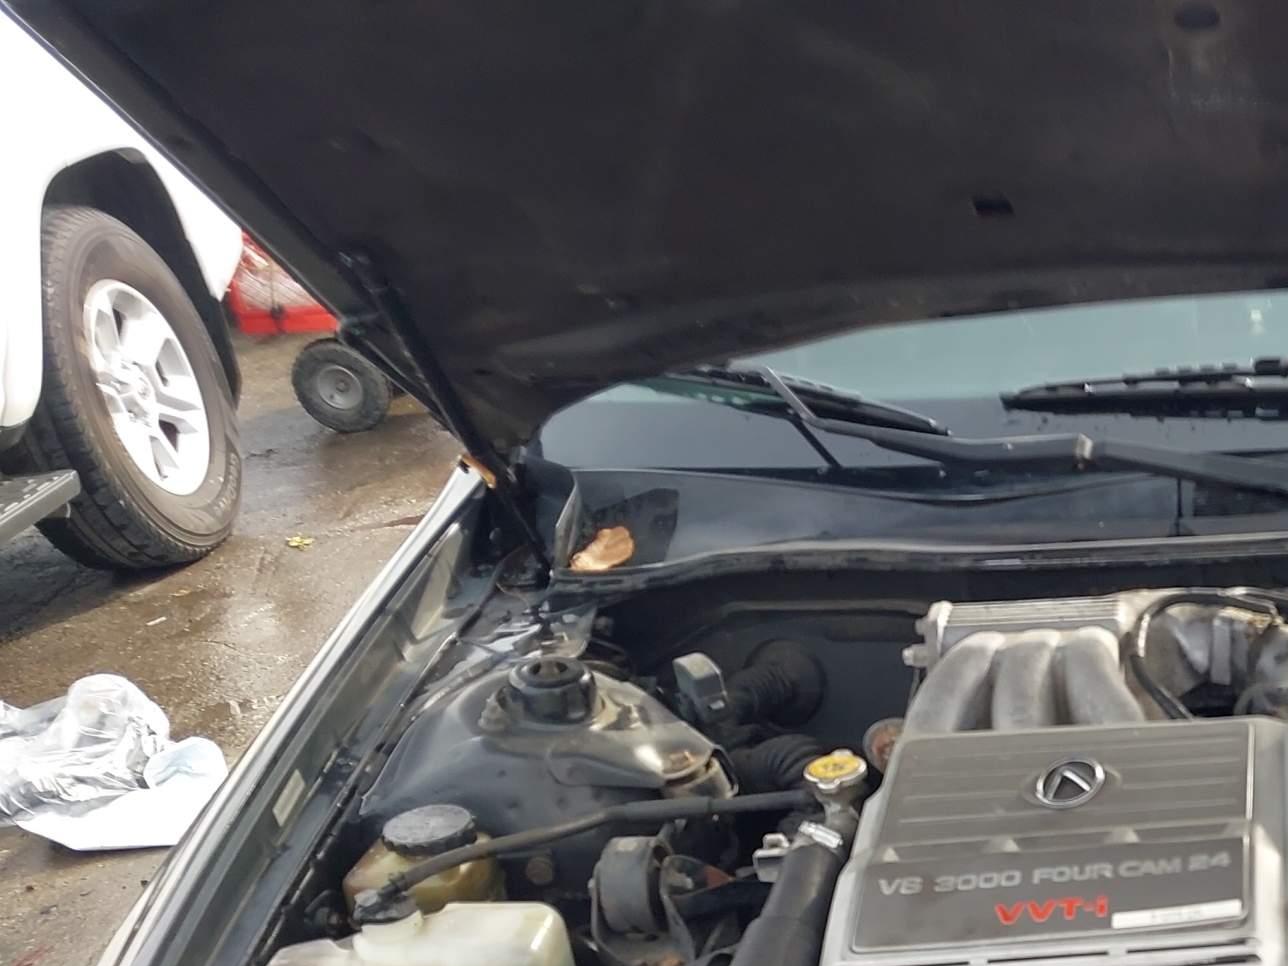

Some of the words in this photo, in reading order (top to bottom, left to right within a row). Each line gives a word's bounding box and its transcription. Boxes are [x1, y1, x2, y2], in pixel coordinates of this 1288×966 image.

[879, 876, 923, 895] V6
[934, 869, 1022, 893] 3000
[1032, 862, 1114, 885] FOUR
[1118, 857, 1183, 878] CAM
[1188, 852, 1231, 872] 24
